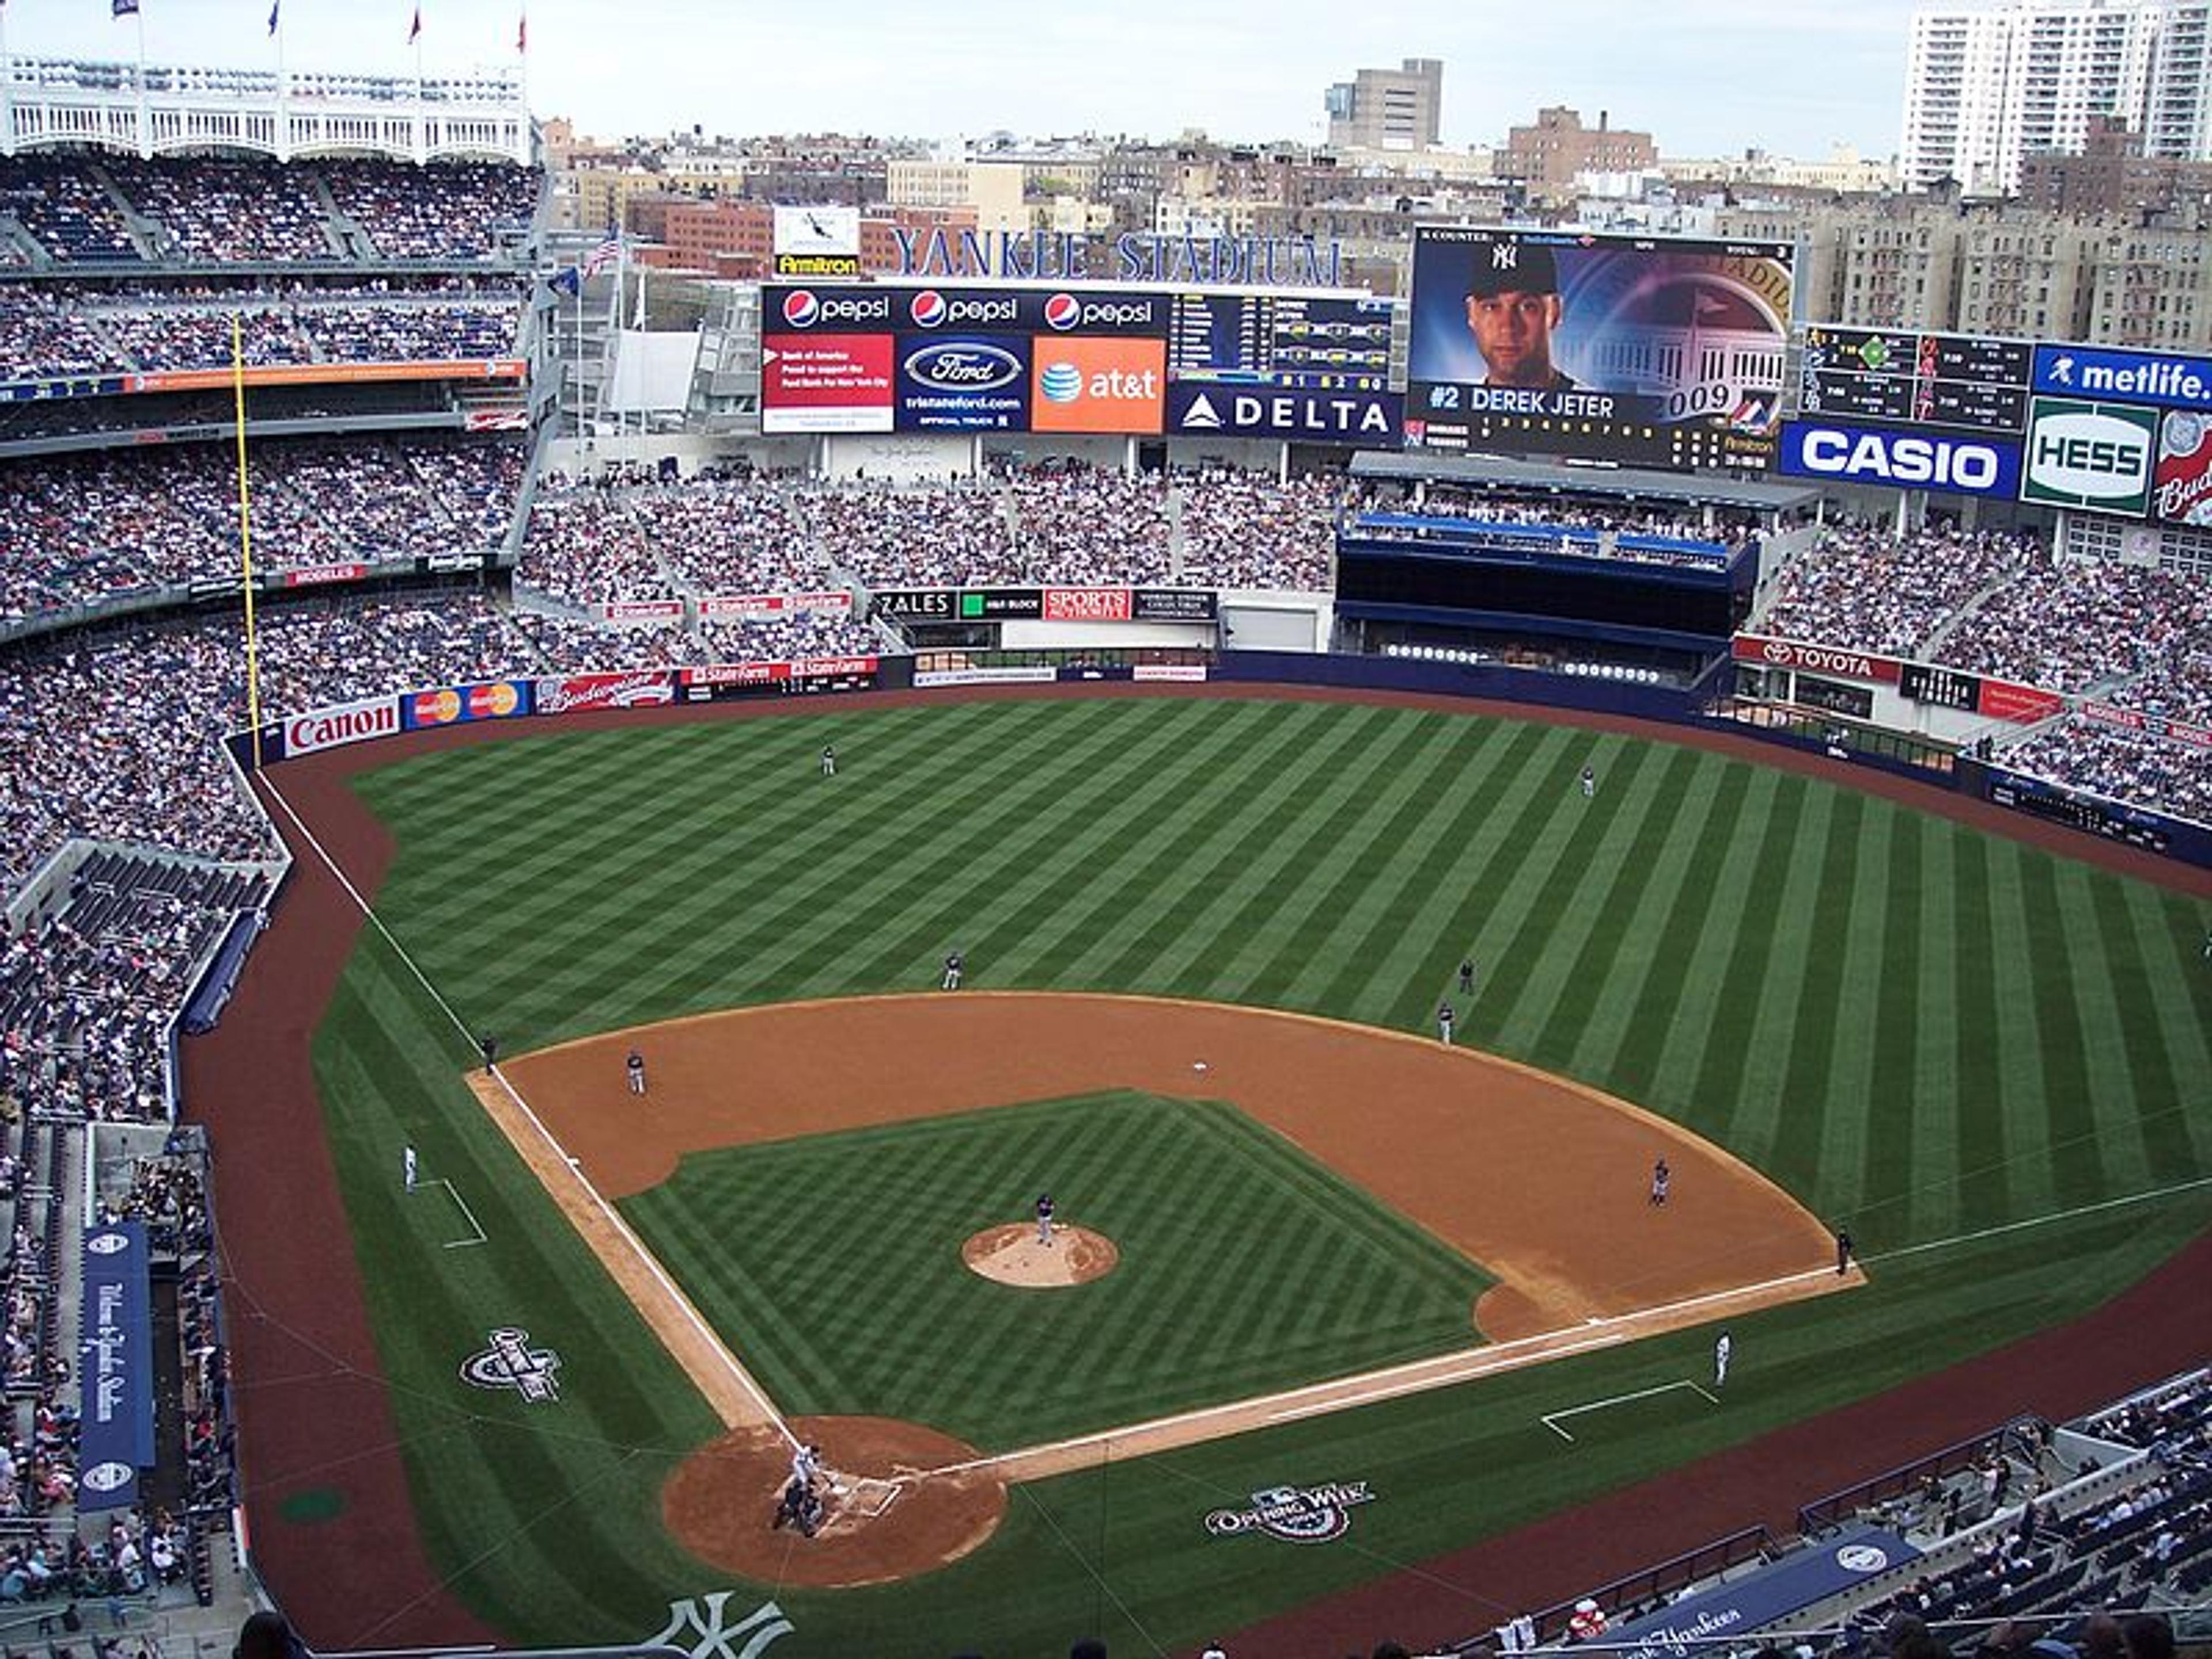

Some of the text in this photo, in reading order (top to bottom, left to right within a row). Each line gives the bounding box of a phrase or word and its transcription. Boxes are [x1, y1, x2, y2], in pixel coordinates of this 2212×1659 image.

[779, 254, 856, 274] Armitron
[1118, 232, 1343, 286] STADIUM
[821, 296, 889, 321] pepsi
[948, 298, 1017, 323] pepsi
[1083, 301, 1152, 325] pepsi
[931, 353, 994, 381] Ford
[2081, 362, 2211, 400] metlife.
[1089, 369, 1157, 399] at&t
[1234, 396, 1389, 433] DELTA
[1430, 387, 1614, 418] #2 DEREK JETER
[1802, 430, 1998, 488] CASIO
[2037, 435, 2143, 477] HESS
[1048, 591, 1126, 608] SPORTS
[1794, 647, 1873, 676] TOYOTA
[290, 706, 394, 749] Canon
[1650, 1609, 1741, 1656] Yankees
